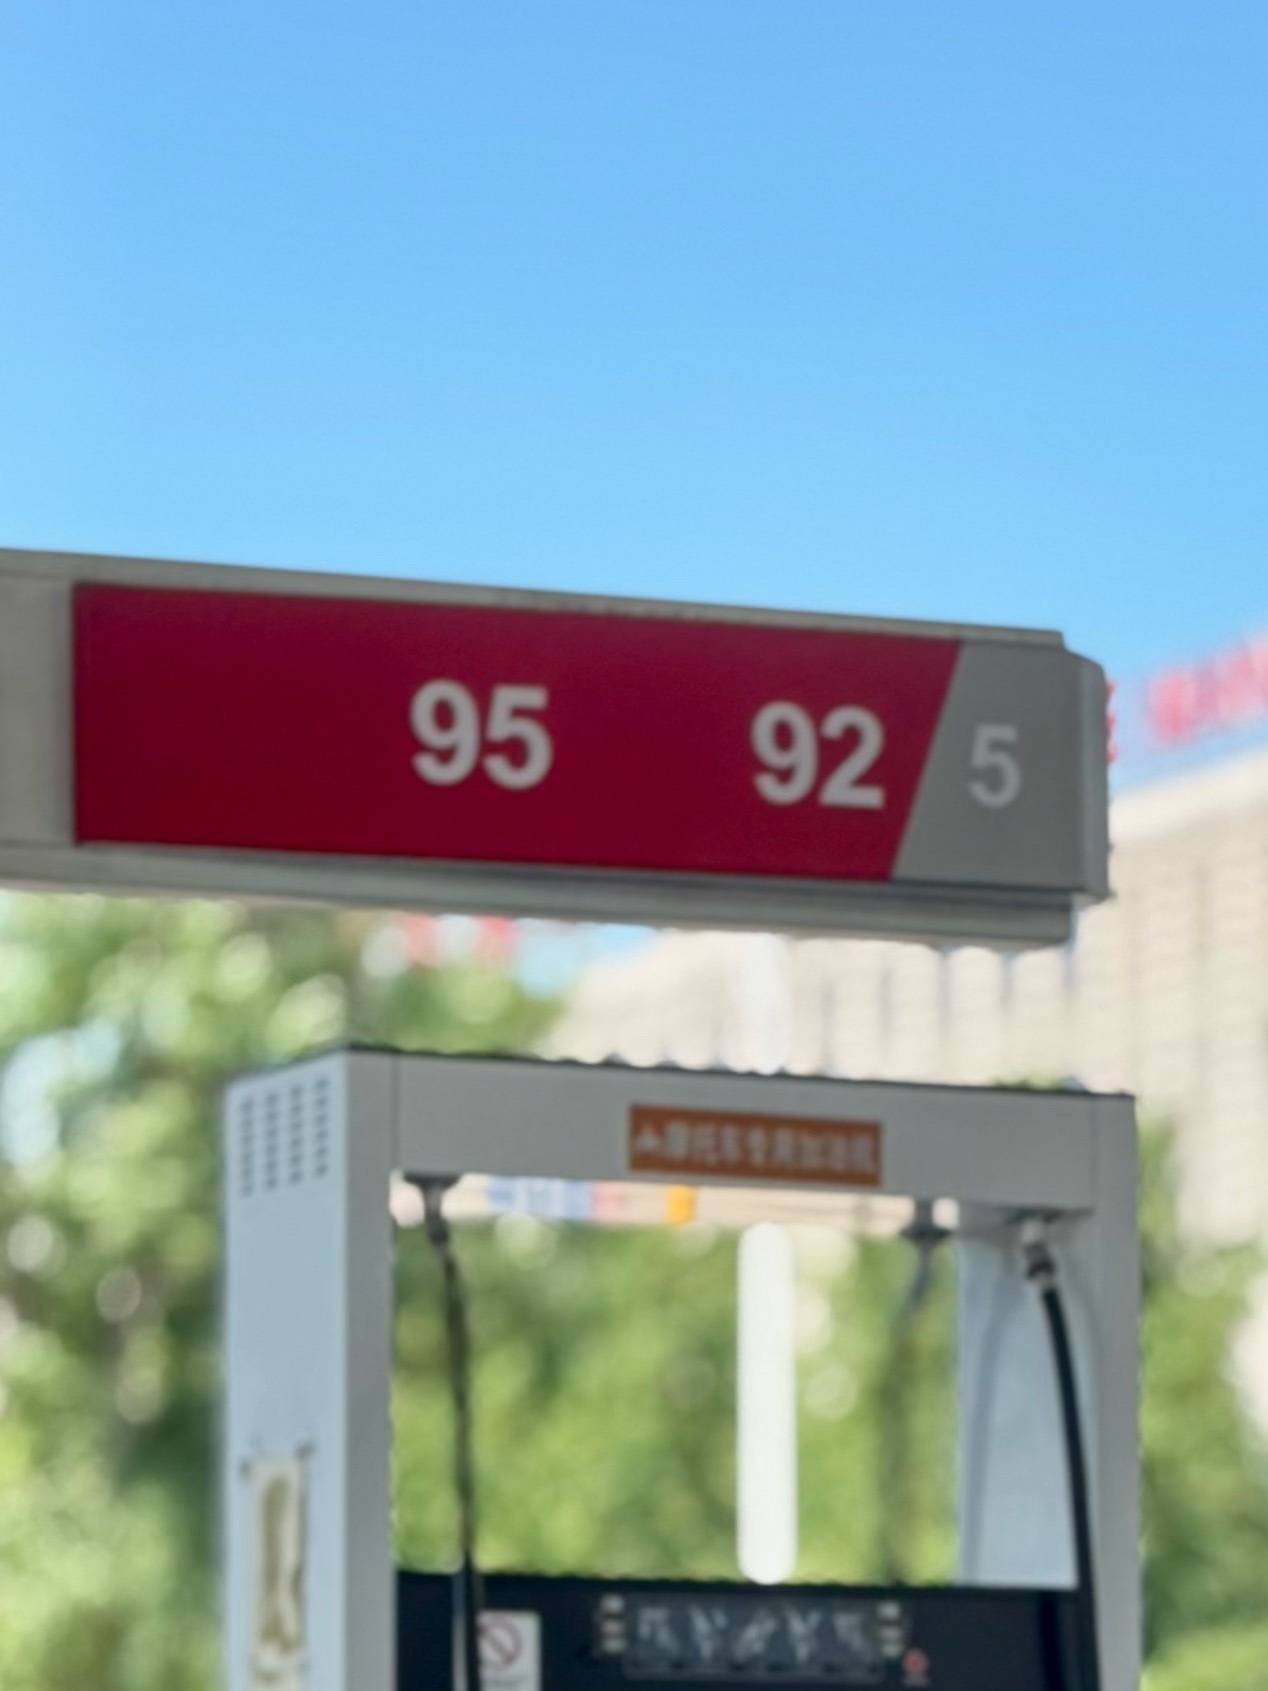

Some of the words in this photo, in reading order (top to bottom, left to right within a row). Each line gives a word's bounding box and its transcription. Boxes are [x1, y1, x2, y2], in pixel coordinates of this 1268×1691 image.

[409, 680, 552, 790] 95
[751, 701, 886, 808] 92
[968, 724, 1021, 808] 5
